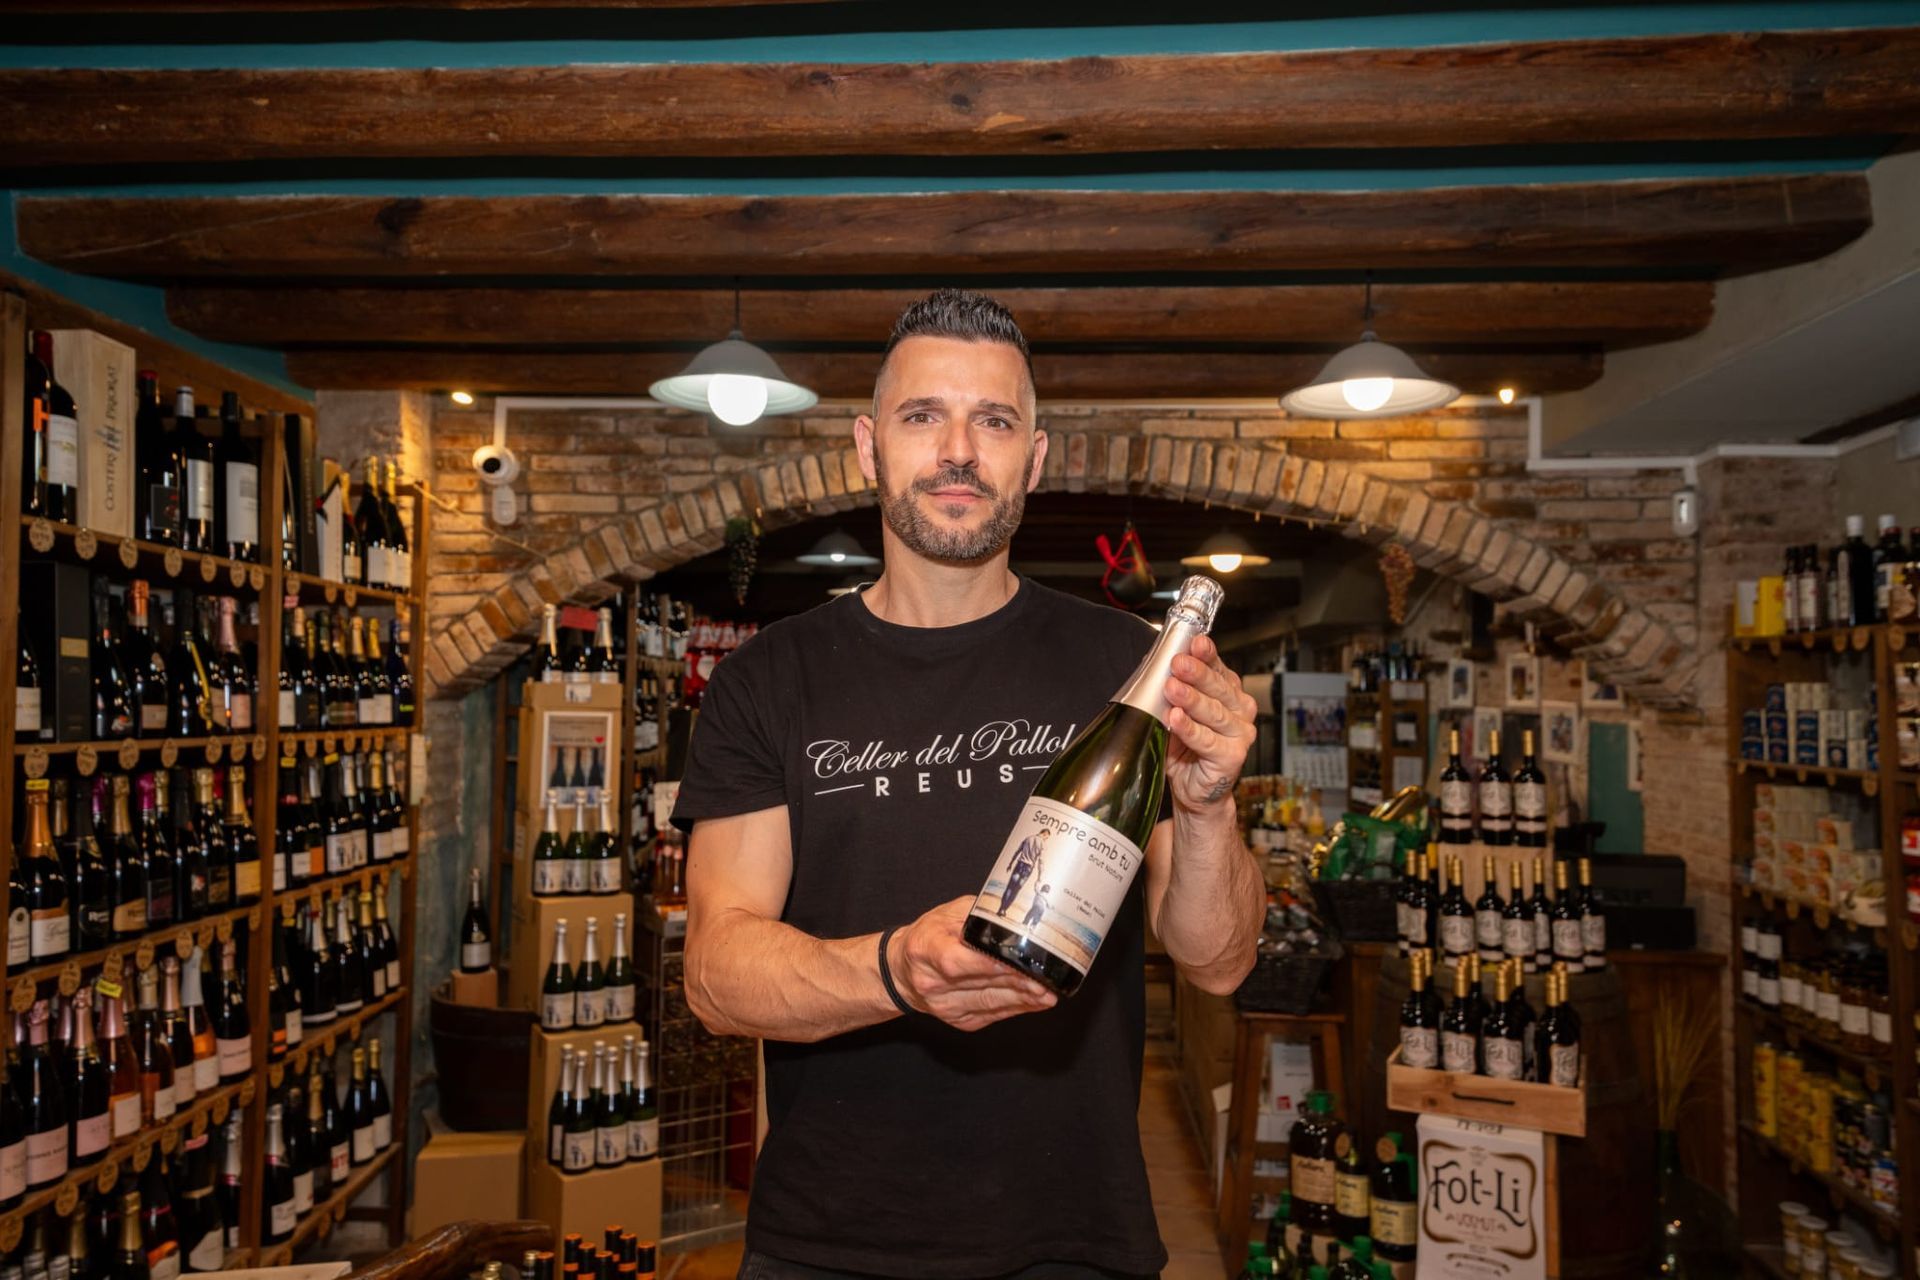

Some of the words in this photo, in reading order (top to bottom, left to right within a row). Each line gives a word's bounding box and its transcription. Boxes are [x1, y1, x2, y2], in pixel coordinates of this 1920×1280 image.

[806, 739, 909, 778] Celler
[915, 734, 964, 765] del
[970, 719, 1076, 761] Pallol
[875, 763, 1015, 797] REUS
[1033, 810, 1087, 842] sempre
[1088, 836, 1118, 860] amb
[1119, 853, 1133, 872] tu
[1428, 1160, 1527, 1227] Fot-Li
